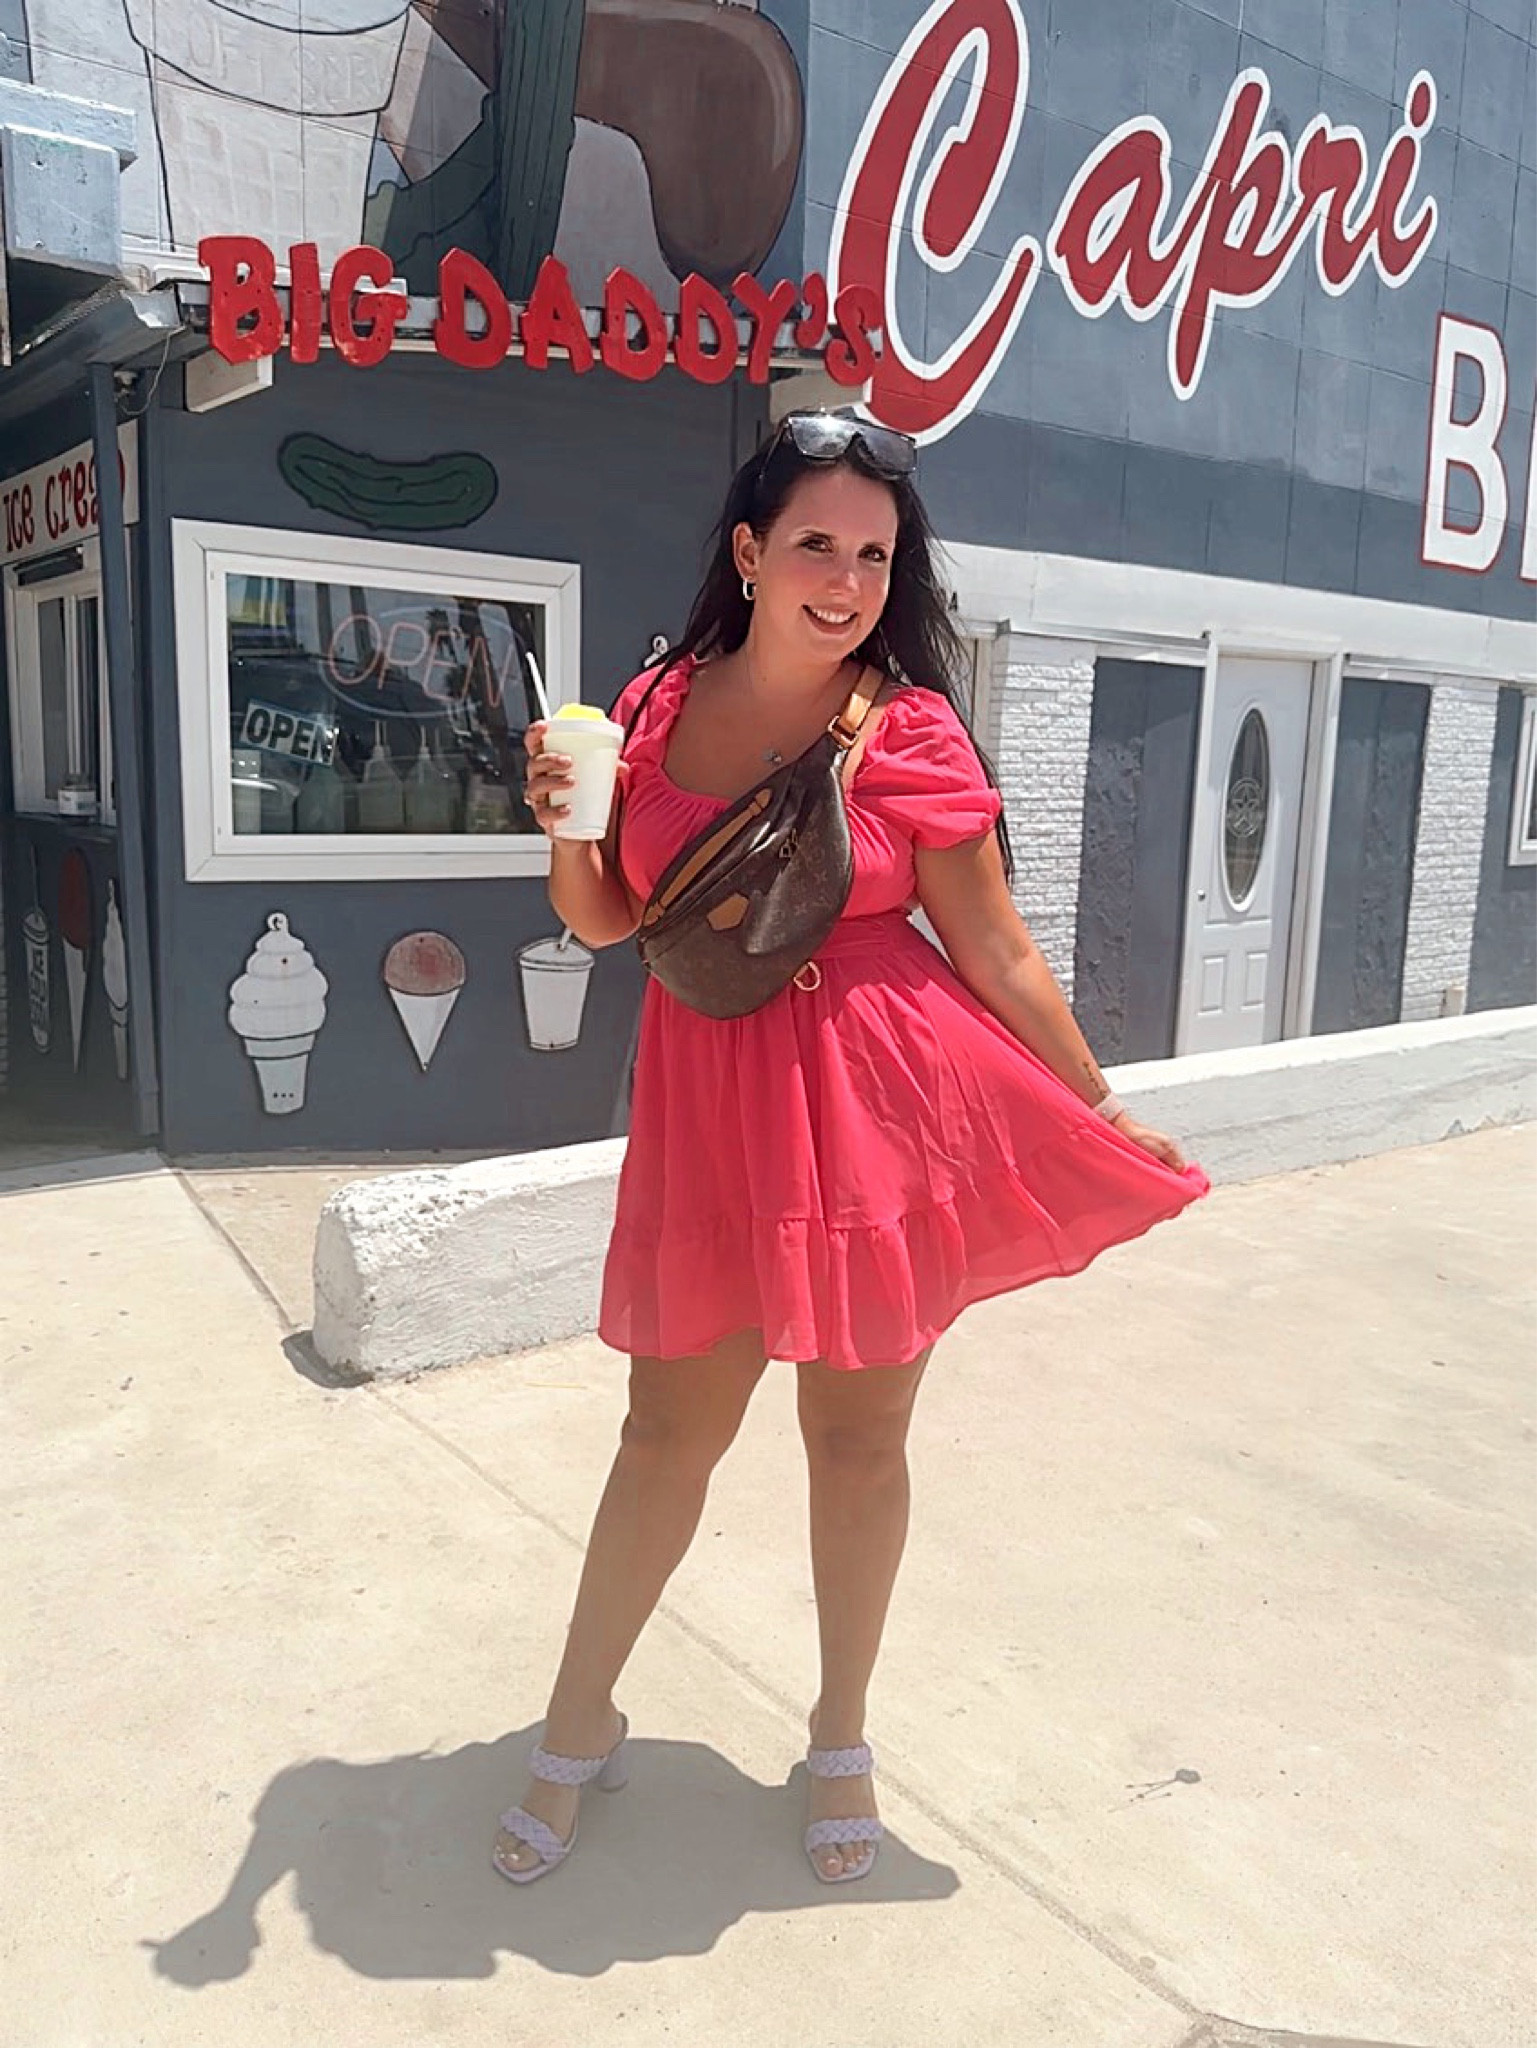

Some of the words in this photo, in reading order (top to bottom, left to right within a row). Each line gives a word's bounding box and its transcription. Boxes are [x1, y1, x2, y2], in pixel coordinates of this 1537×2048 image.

[829, 0, 1438, 446] Capri
[198, 235, 408, 368] BIG
[434, 246, 884, 386] DADDY'S
[1421, 311, 1537, 585] B
[246, 708, 333, 764] OPEN
[329, 613, 517, 708] OPEN
